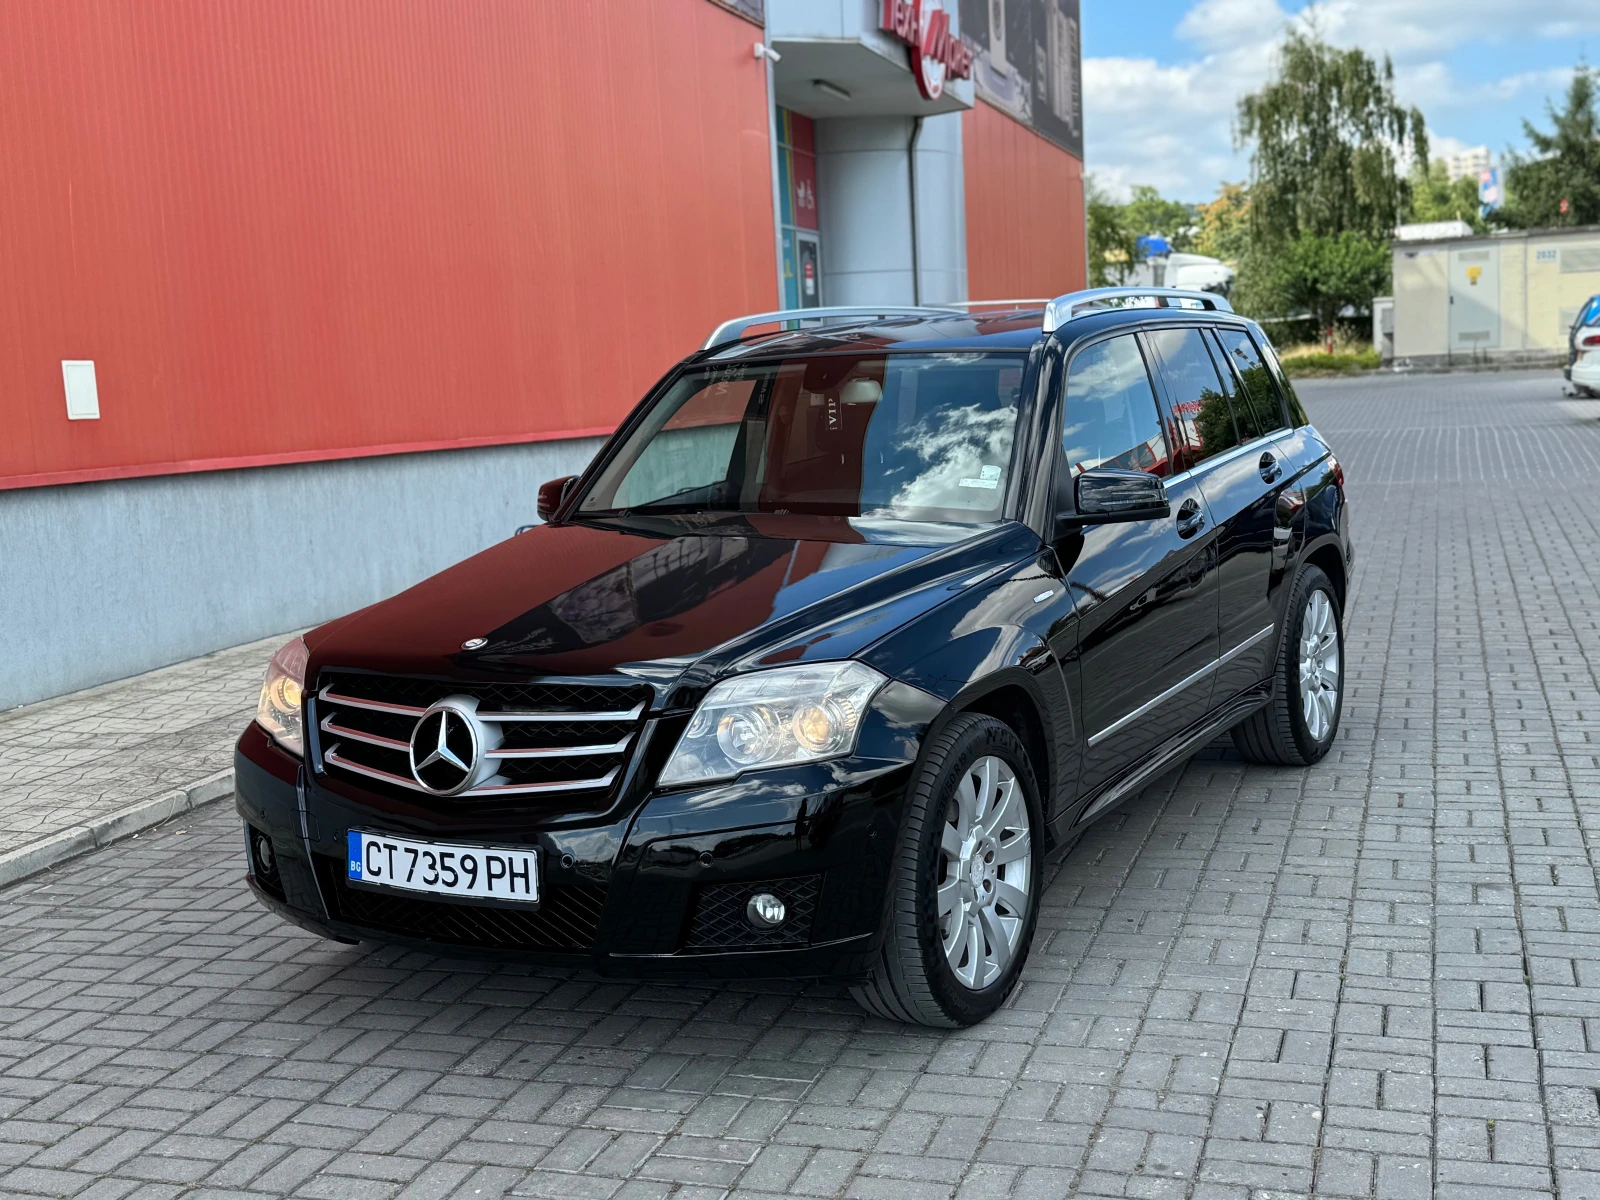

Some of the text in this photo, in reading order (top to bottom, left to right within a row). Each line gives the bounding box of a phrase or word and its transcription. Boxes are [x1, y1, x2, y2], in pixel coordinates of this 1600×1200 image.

[350, 860, 362, 872] BG
[366, 841, 531, 894] CT 7359 PH
